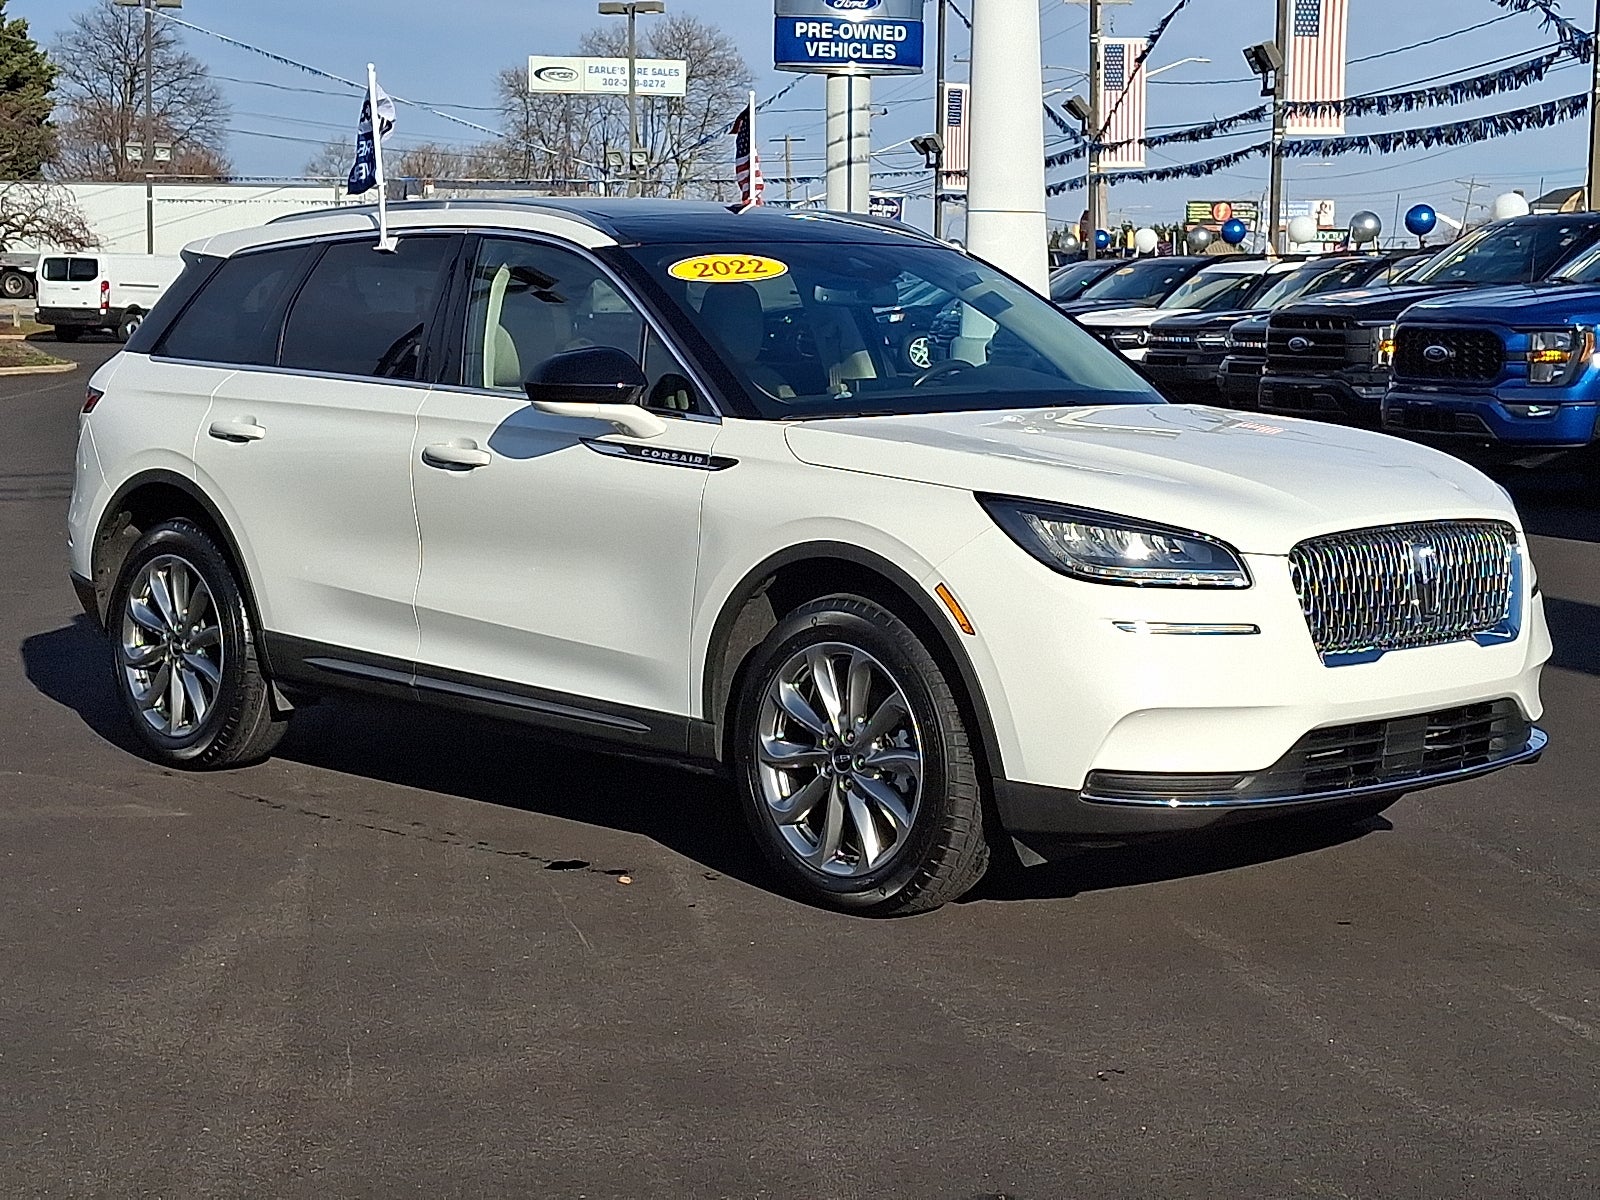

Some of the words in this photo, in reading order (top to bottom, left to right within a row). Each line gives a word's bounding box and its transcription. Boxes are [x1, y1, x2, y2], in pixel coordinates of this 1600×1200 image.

[795, 21, 907, 42] PRE-OWNED
[805, 41, 897, 60] VEHICLES
[588, 65, 626, 75] EARLE'S
[651, 67, 680, 77] SALES
[693, 258, 768, 278] 2022
[641, 448, 704, 464] CORSAIR
